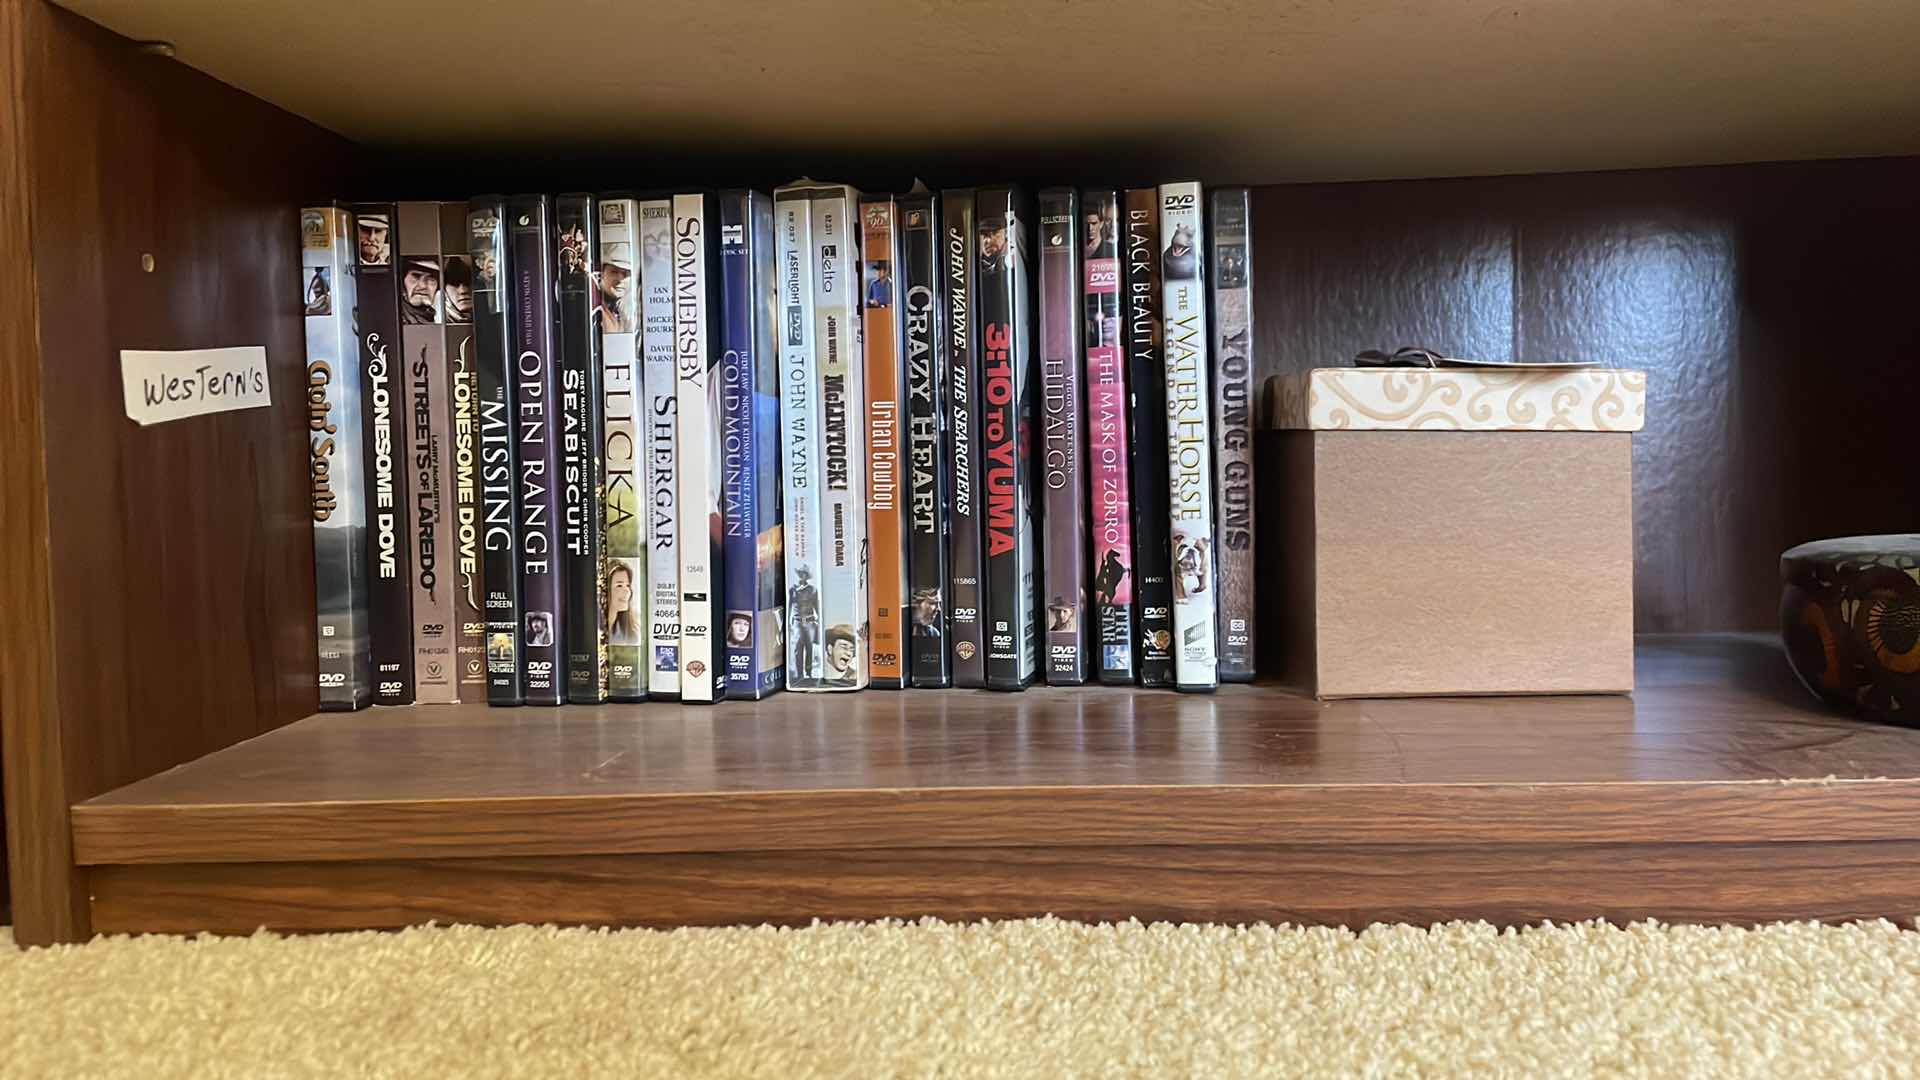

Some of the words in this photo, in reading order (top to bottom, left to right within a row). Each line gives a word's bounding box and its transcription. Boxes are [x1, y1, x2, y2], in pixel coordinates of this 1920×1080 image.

[1165, 195, 1195, 204] DVD
[822, 245, 837, 293] delta
[950, 228, 964, 285] JOHN
[1130, 209, 1151, 273] BLACK
[676, 217, 702, 388] SOMMERSBY
[786, 250, 799, 304] LASERLIGHT
[1090, 273, 1115, 281] DVD
[1178, 286, 1188, 310] THE
[827, 316, 837, 337] JOHN
[907, 285, 933, 403] CRAZY
[952, 286, 967, 349] WAYNE
[1132, 282, 1153, 360] BEAUTY
[723, 350, 740, 410] COLD
[791, 354, 806, 409] JOHN
[828, 339, 838, 364] WAYNE
[985, 323, 1014, 405] 3:10
[1099, 351, 1113, 385] THE
[1165, 317, 1175, 388] LEGEND
[1175, 315, 1199, 416] WATER
[308, 360, 337, 434] Goin'
[412, 361, 431, 470] STREETS
[519, 350, 544, 444] OPEN
[953, 365, 967, 403] THE
[1065, 375, 1074, 407] VIGGO
[1168, 400, 1177, 422] OF
[1222, 329, 1248, 452] YOUNG
[373, 374, 393, 508] LONESOME
[454, 371, 474, 502] LONESOME
[605, 364, 635, 528] FLICKA
[824, 374, 847, 491] McLINTOCK!
[872, 401, 895, 447] Urban
[987, 407, 1005, 439] TO
[1046, 359, 1066, 490] HIDALGO
[1066, 411, 1075, 474] MORTENSEN
[1101, 394, 1116, 442] MASK
[1168, 433, 1178, 466] THE
[312, 437, 337, 521] South
[417, 471, 429, 490] OF
[481, 400, 512, 551] MISSING
[563, 369, 581, 555] SEABISCUIT
[654, 396, 678, 551] SHERGAR
[725, 416, 741, 536] MOUNTAIN
[792, 418, 808, 489] WAYNE
[868, 453, 896, 509] Cowboy
[910, 412, 936, 534] HEART
[954, 406, 970, 516] SEARCHERS
[1102, 450, 1116, 473] OF
[1178, 418, 1204, 521] HORSE
[522, 460, 548, 574] RANGE
[987, 439, 1016, 557] YUMA
[1102, 479, 1119, 544] ZORRO
[1170, 479, 1180, 521] DEEP
[1224, 460, 1249, 551] GUNS
[378, 513, 396, 579] DOVE
[417, 491, 436, 591] LAREDO
[459, 507, 476, 574] DOVE
[491, 592, 507, 600] FULL
[655, 610, 680, 618] 40664
[1102, 606, 1116, 642] STAR
[1116, 606, 1129, 641] TRI
[653, 624, 681, 634] DVD
[1051, 646, 1076, 654] DVD
